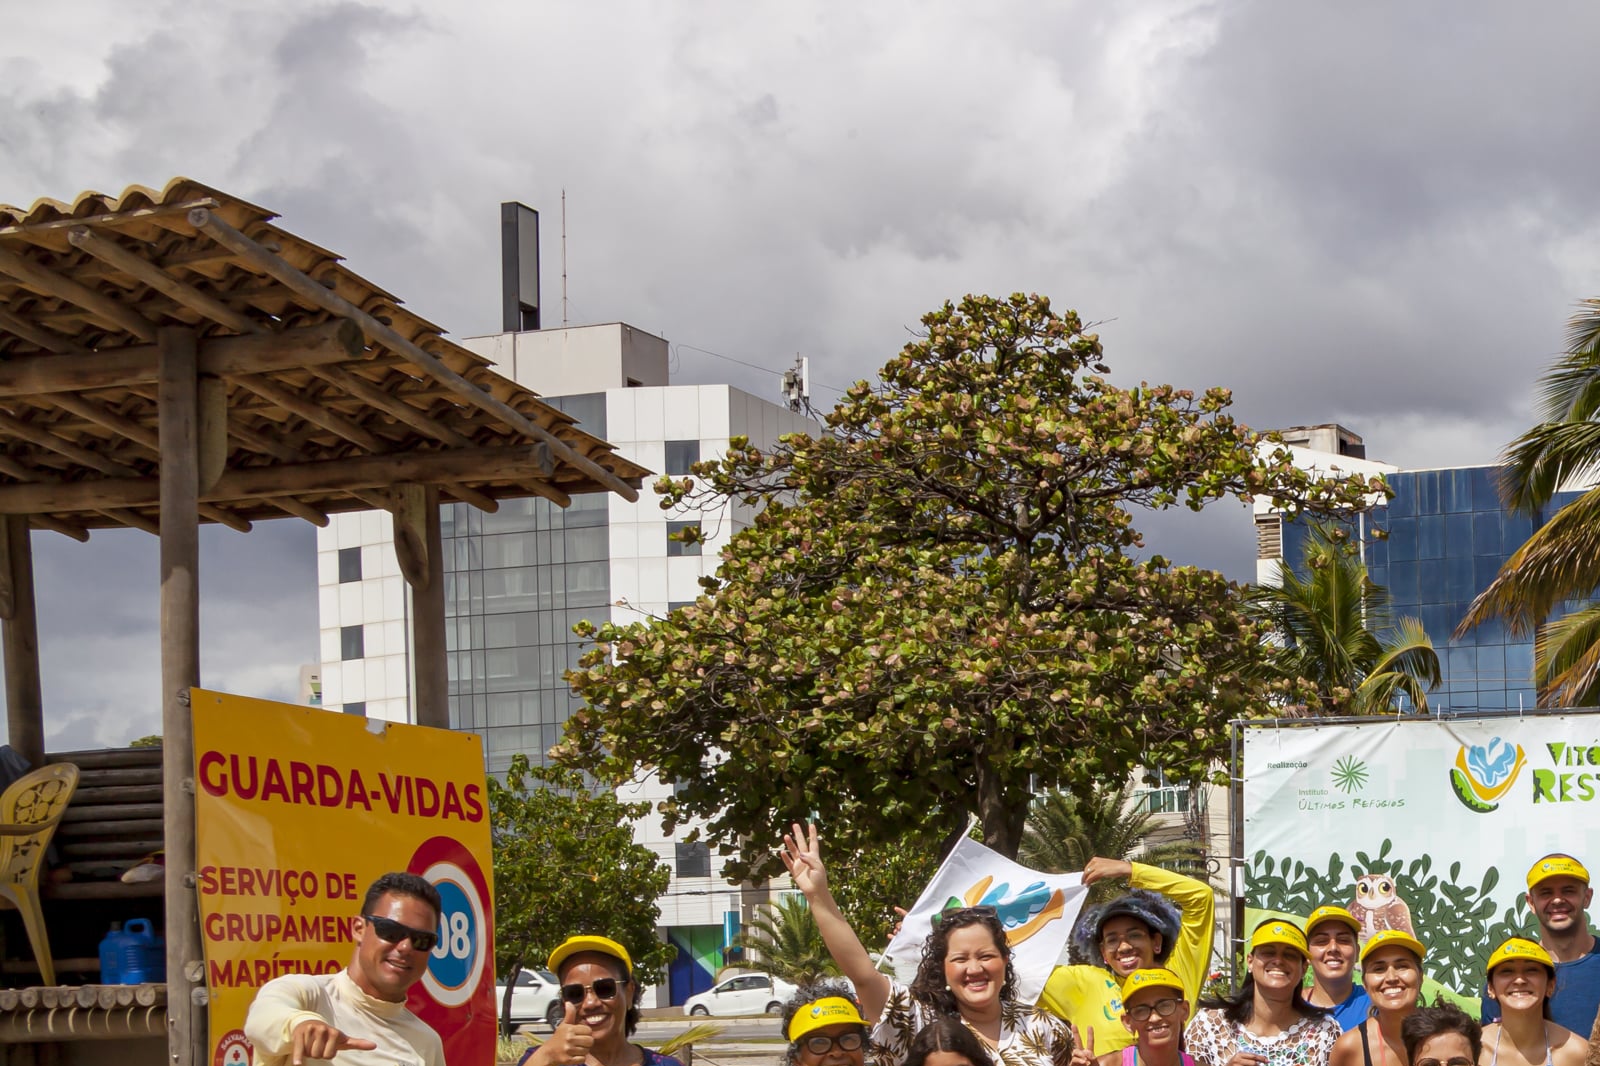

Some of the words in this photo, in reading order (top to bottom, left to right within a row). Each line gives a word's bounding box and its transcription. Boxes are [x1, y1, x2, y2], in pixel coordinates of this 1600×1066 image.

[1267, 761, 1308, 769] Realização
[199, 750, 483, 823] GUARDA-VIDAS
[201, 866, 318, 906] SERVIÇO
[326, 873, 357, 900] DE
